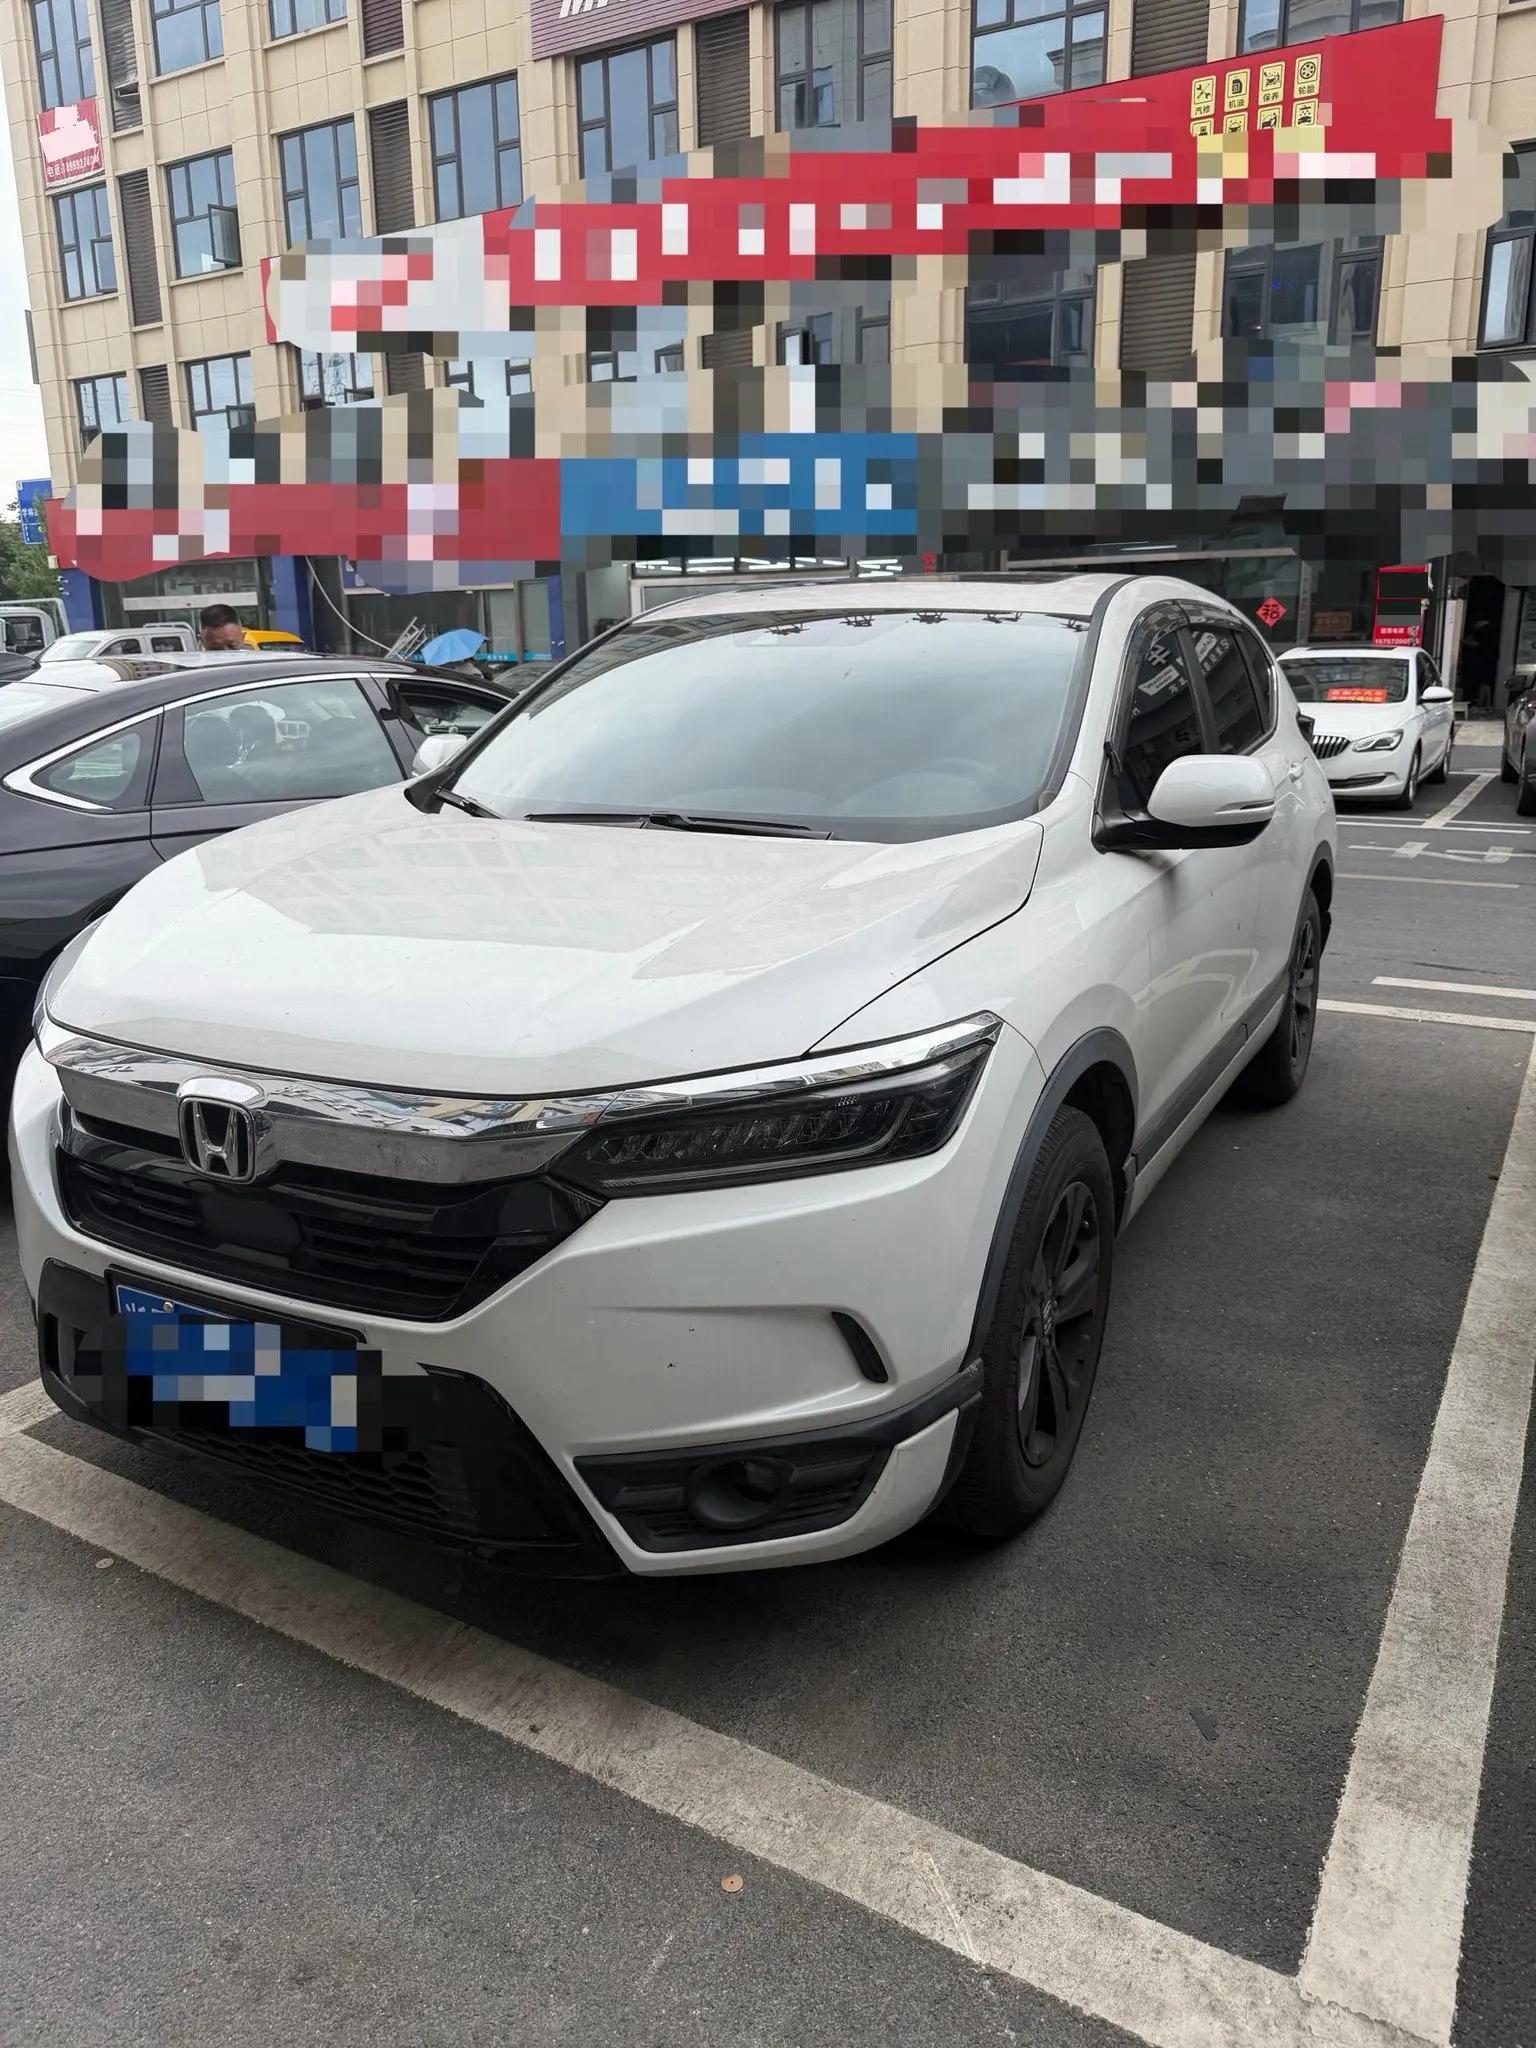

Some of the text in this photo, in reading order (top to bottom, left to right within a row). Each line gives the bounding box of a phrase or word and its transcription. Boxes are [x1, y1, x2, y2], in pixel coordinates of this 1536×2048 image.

[1298, 84, 1316, 95] 轮胎
[1262, 91, 1280, 102] 保养
[1228, 98, 1245, 109] 机油
[1194, 105, 1211, 116] 汽修
[1260, 603, 1280, 620] 福
